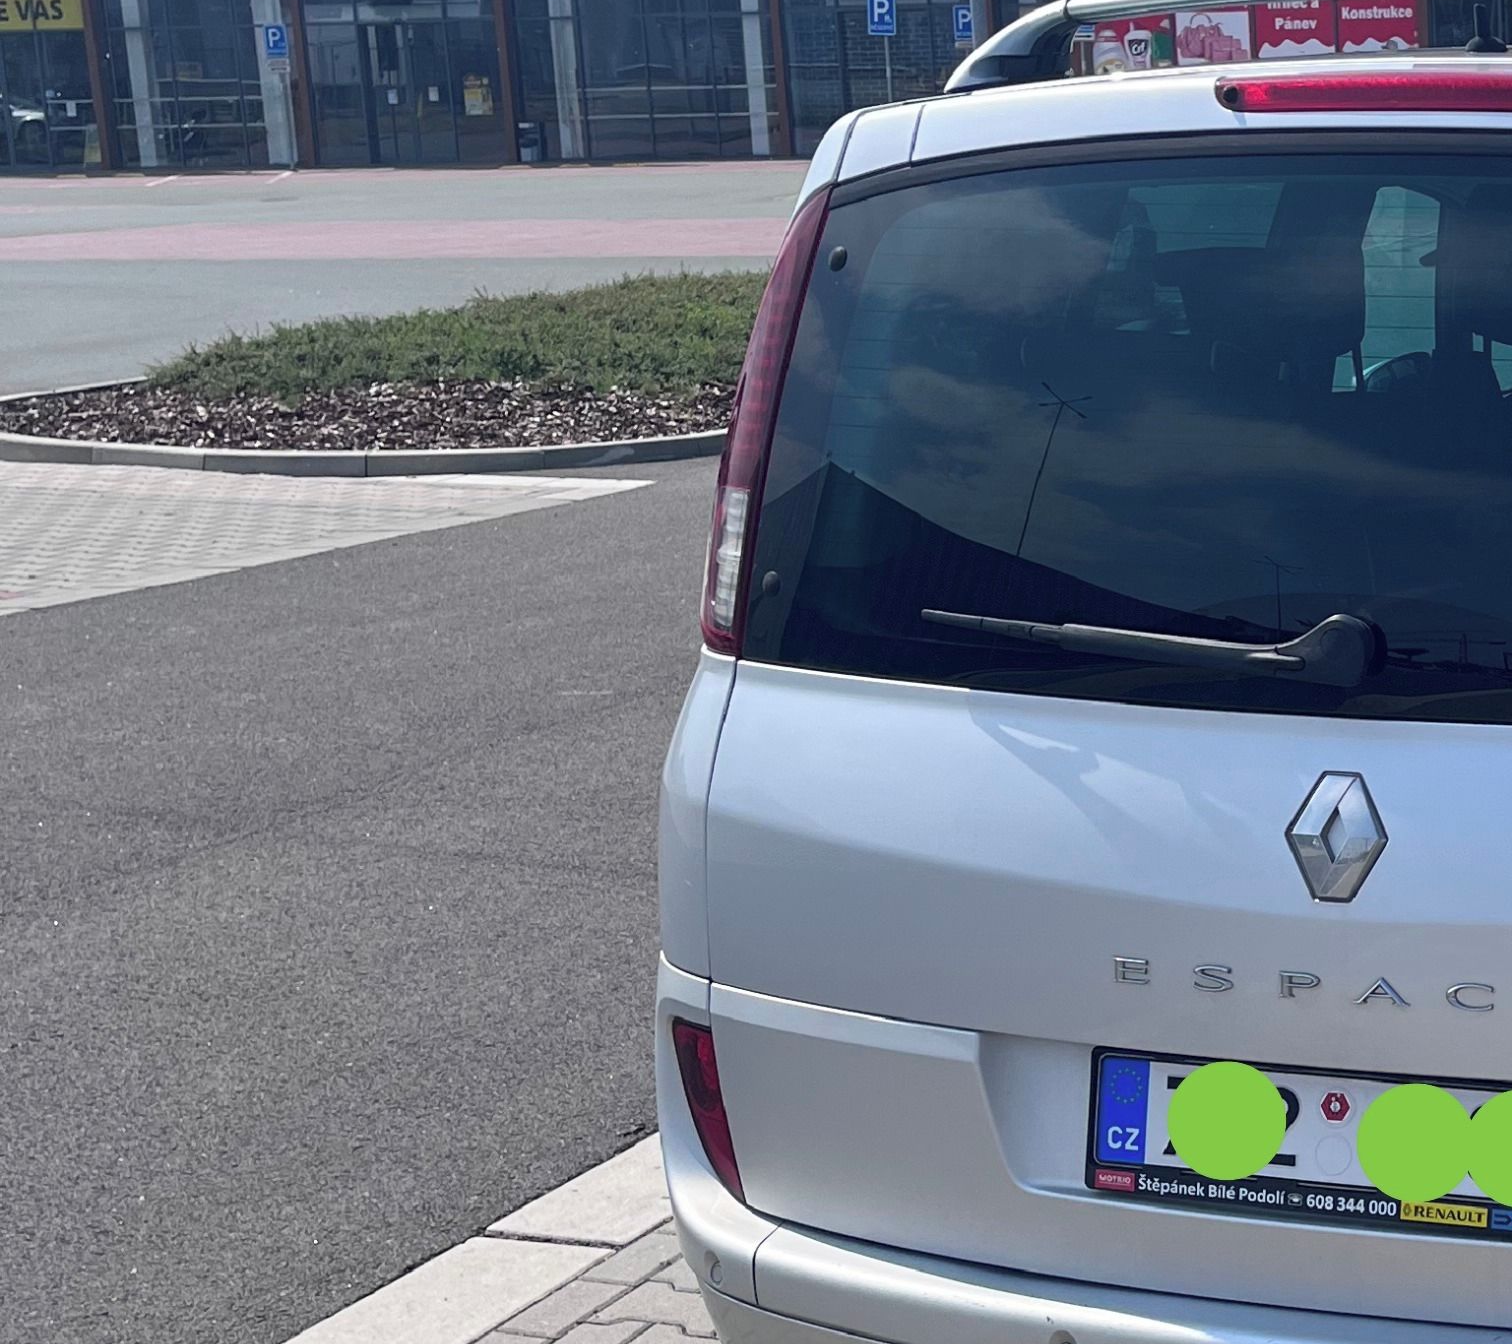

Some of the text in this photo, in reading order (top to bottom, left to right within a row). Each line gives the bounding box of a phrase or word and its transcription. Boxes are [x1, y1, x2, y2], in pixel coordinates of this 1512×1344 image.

[958, 9, 973, 30] P
[1274, 16, 1318, 30] Pánev
[1341, 6, 1413, 20] Konstrukce
[268, 28, 281, 48] P
[1107, 1125, 1140, 1151] CZ
[1138, 1174, 1397, 1217] Štěpánek Bílé Podolí 608 344 000
[1413, 1205, 1486, 1223] RENAULT
